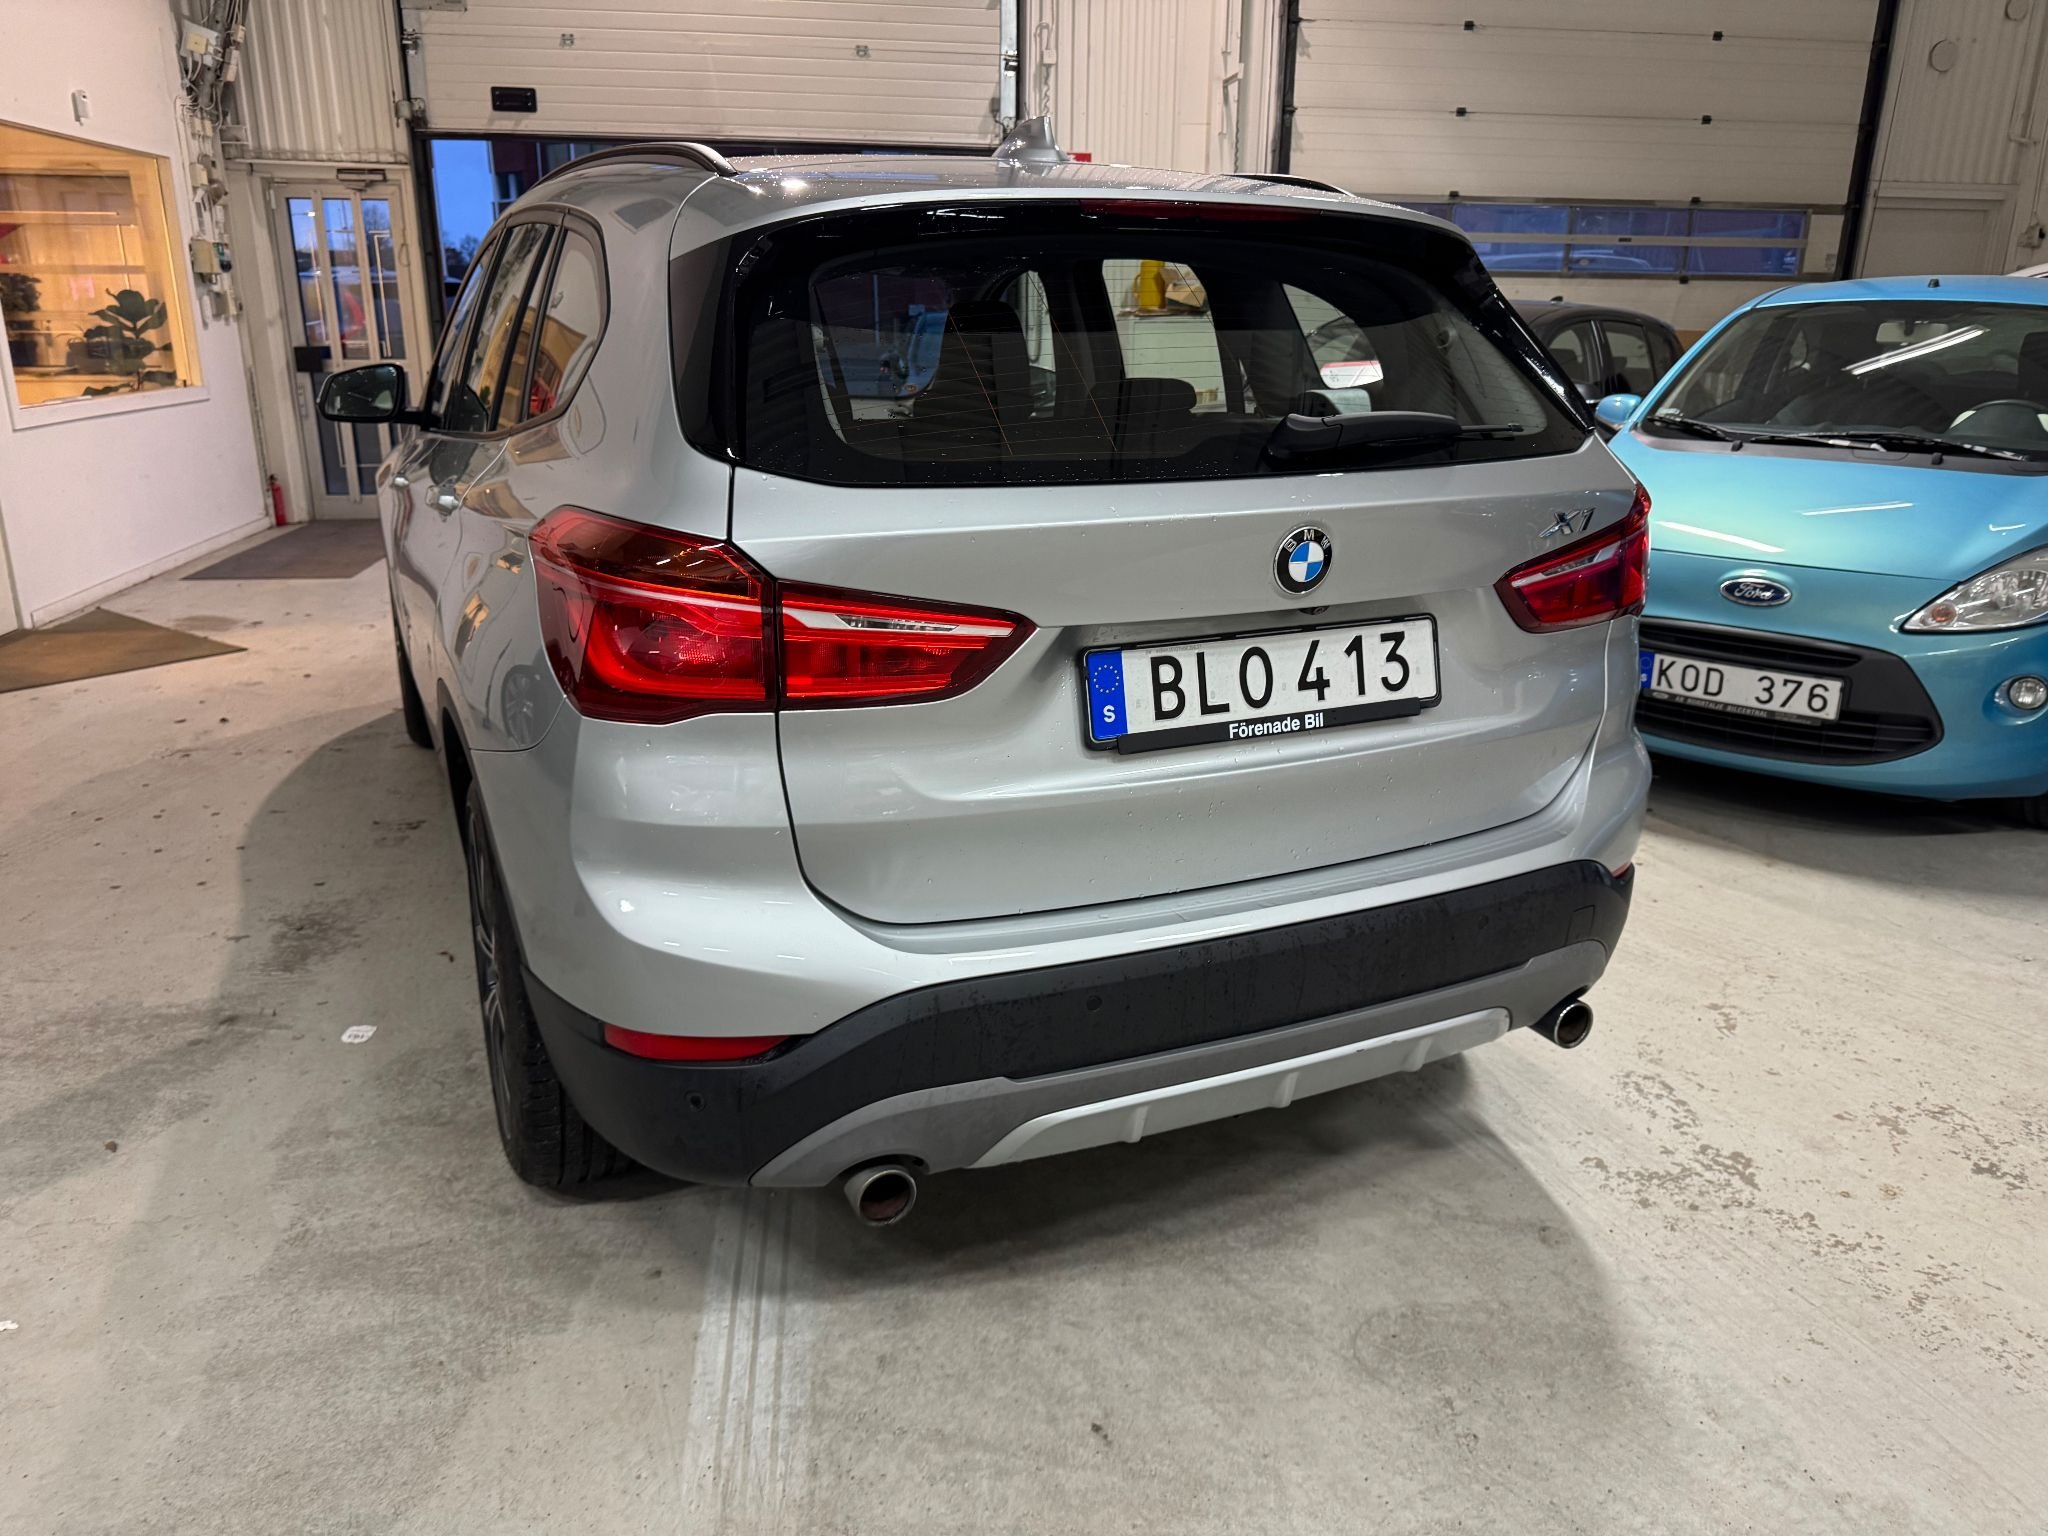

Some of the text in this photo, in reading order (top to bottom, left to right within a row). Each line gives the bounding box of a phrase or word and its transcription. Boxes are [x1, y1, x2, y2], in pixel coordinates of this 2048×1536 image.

[1538, 507, 1596, 538] X1
[1284, 529, 1331, 553] BMW
[1734, 582, 1775, 599] Ford
[1150, 630, 1410, 721] BLO 413
[1656, 658, 1829, 713] KOD 376
[1103, 704, 1116, 723] S
[1229, 711, 1324, 739] Förenade Bil
